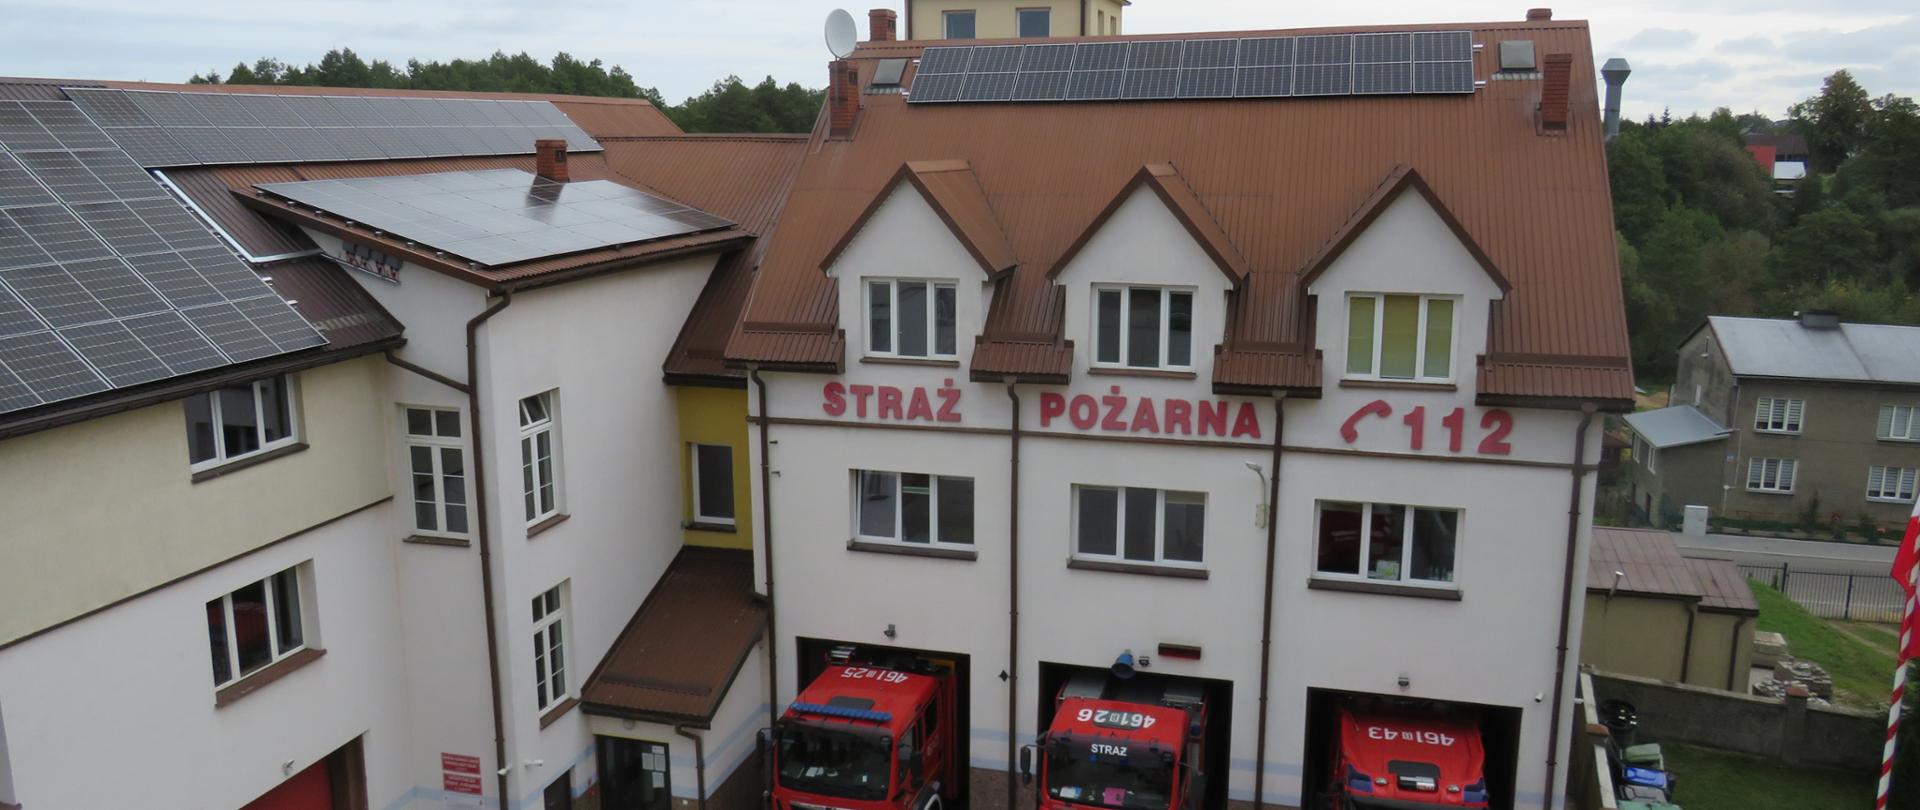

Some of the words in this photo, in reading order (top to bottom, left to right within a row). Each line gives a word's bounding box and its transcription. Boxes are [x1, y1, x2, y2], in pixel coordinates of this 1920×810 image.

[823, 378, 962, 423] STRAŻ
[1040, 385, 1261, 439] POŻARNA
[1403, 406, 1513, 456] 112
